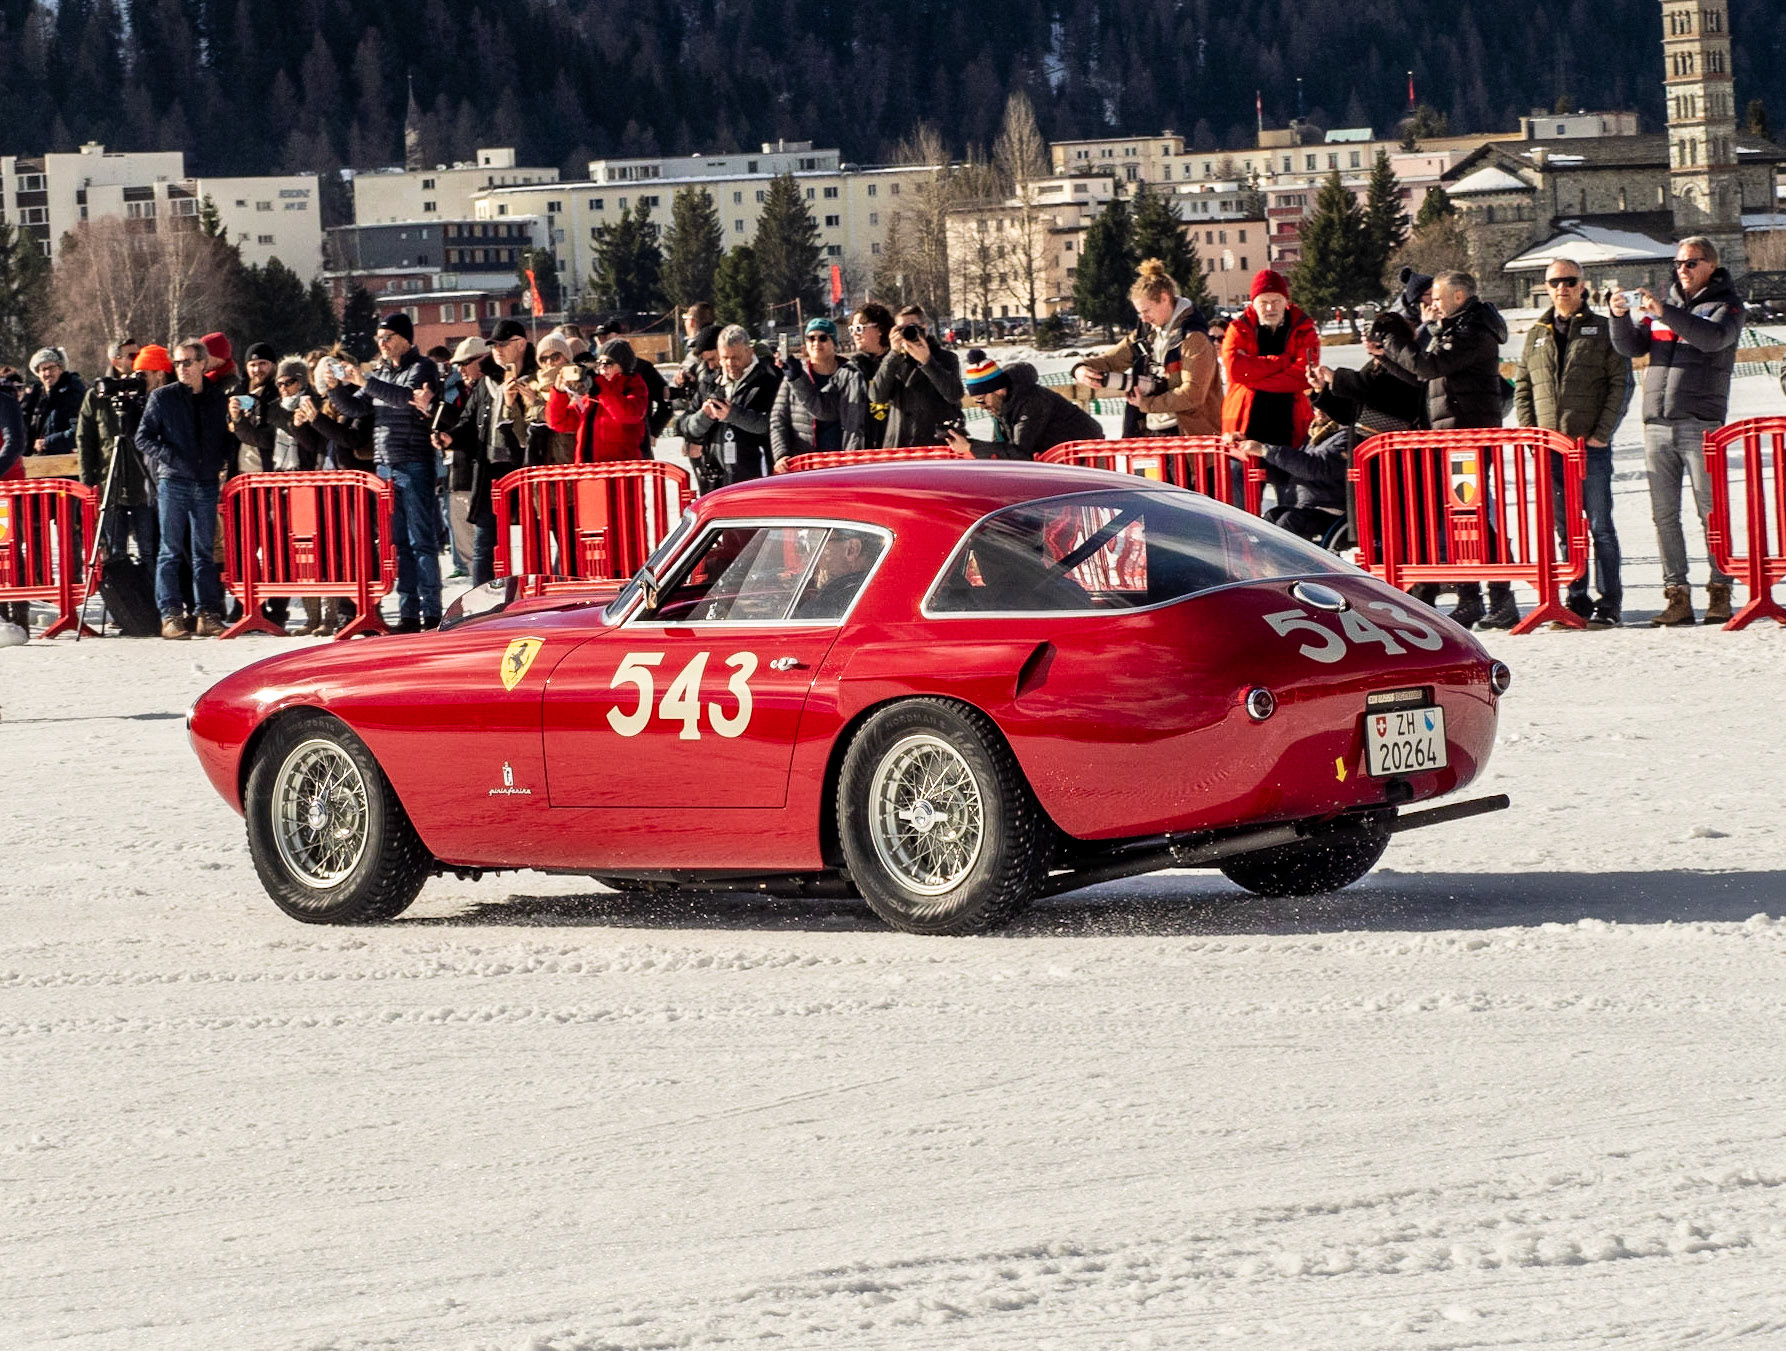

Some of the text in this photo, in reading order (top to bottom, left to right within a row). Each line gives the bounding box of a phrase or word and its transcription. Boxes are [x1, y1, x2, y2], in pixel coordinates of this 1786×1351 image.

[1261, 600, 1444, 664] 543
[605, 650, 759, 741] 543
[1397, 712, 1416, 736] ZH
[1379, 738, 1438, 773] 20264
